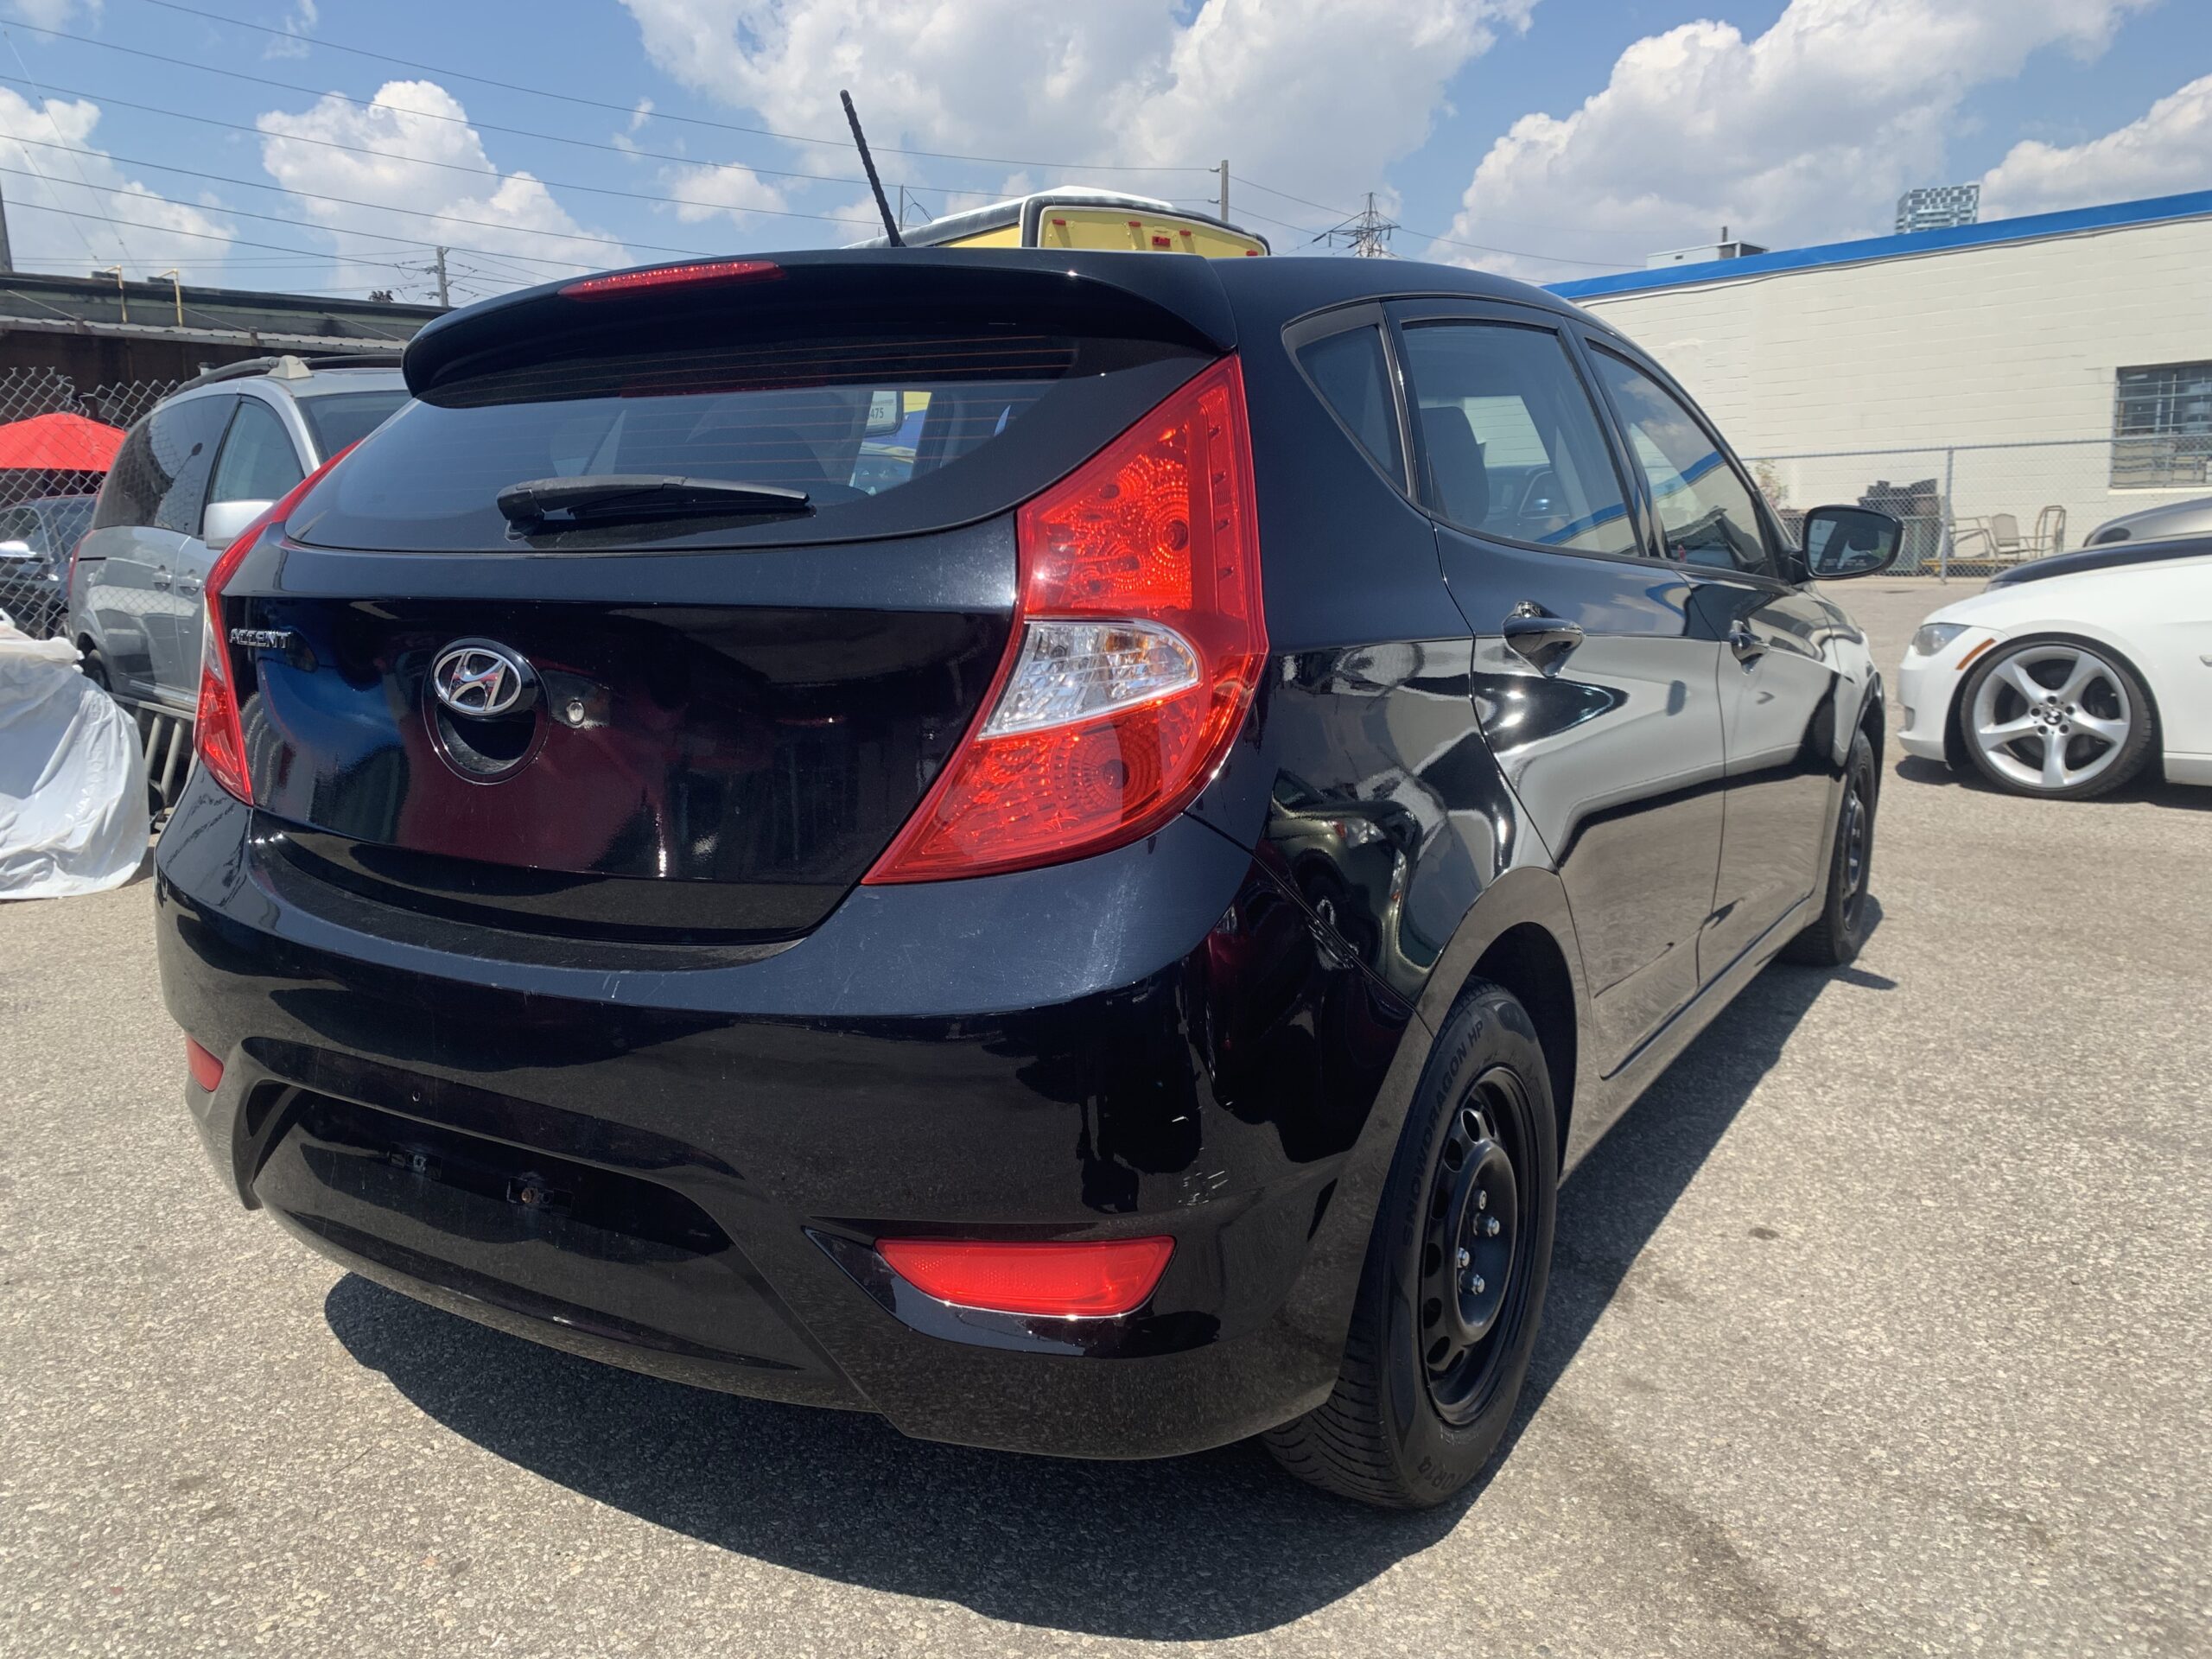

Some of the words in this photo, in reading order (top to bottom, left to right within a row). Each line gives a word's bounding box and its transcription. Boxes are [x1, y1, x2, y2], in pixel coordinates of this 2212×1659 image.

[229, 628, 292, 648] ACCENT
[1402, 1043, 1467, 1247] SNOWDRAGON
[1467, 1020, 1484, 1049] HP
